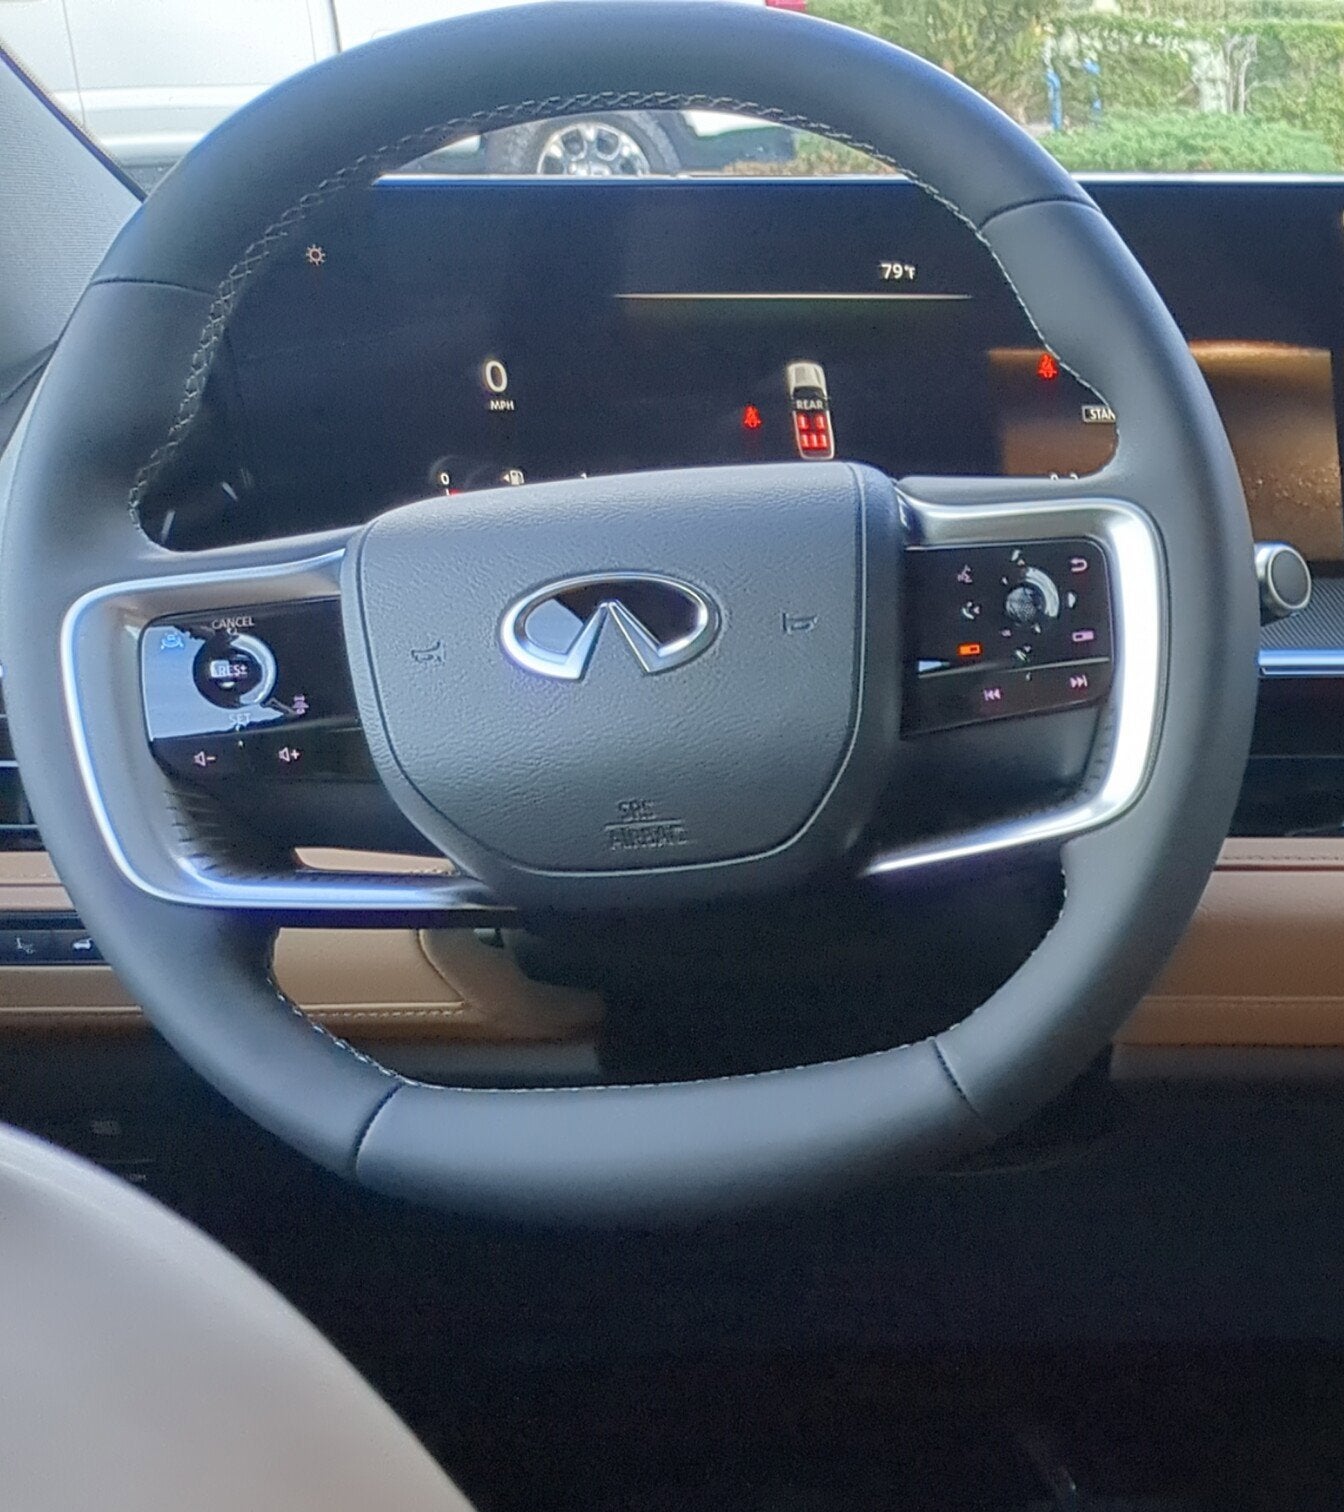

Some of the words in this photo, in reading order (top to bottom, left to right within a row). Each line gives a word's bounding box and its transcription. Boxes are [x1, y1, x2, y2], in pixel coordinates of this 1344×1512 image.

[484, 360, 508, 392] 0
[490, 399, 514, 411] MPH
[796, 399, 825, 409] REAR
[212, 615, 256, 629] CANCEL
